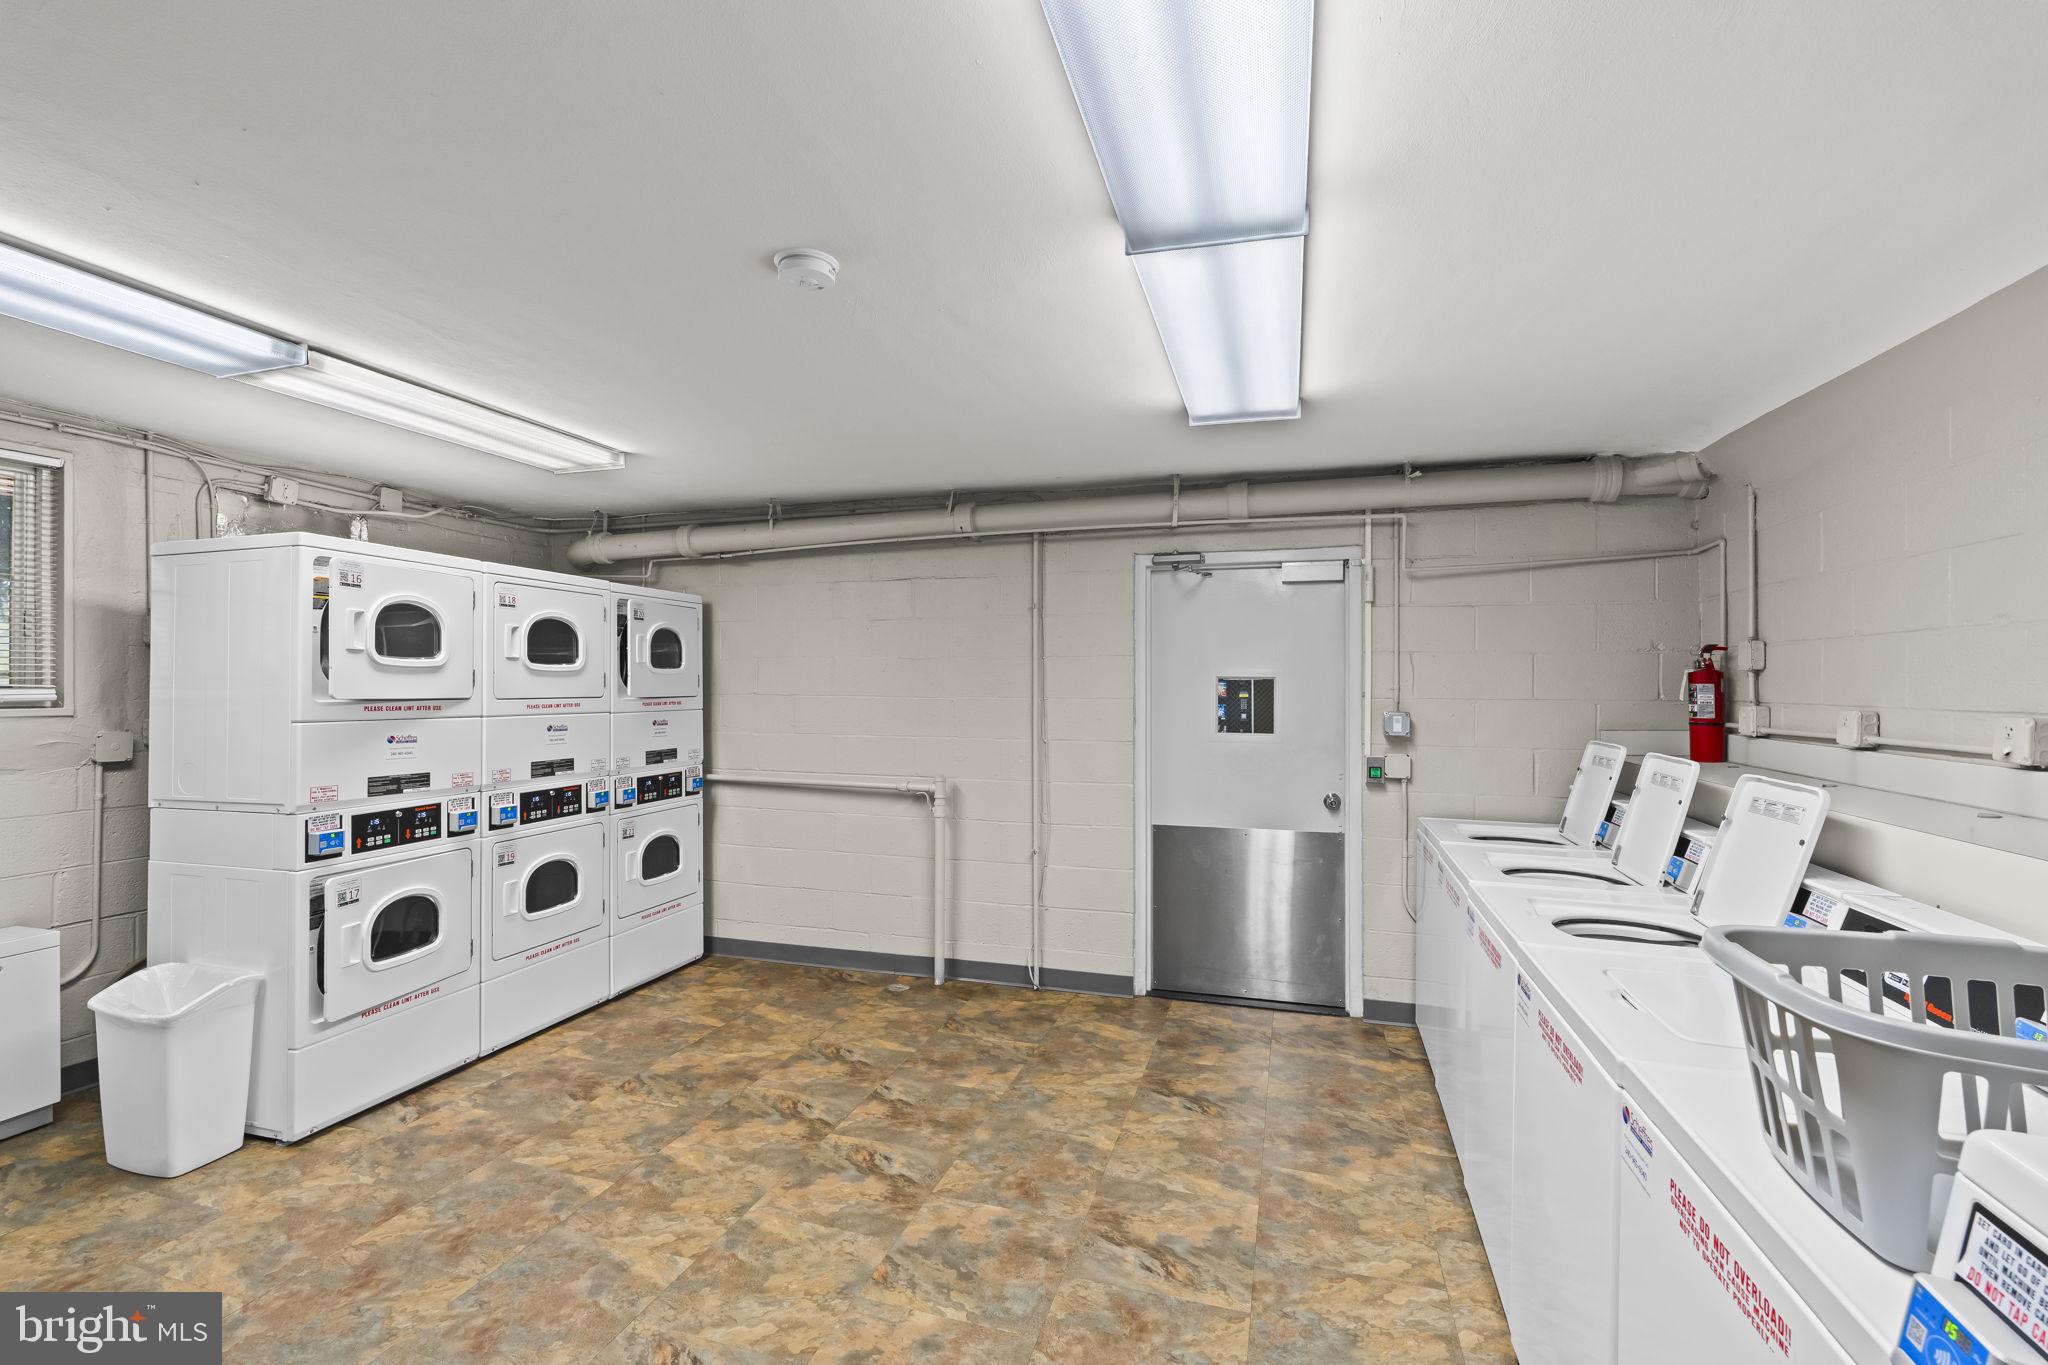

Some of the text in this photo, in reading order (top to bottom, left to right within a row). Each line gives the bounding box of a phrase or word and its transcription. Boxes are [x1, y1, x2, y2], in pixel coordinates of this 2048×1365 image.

[351, 574, 362, 583] 16
[508, 596, 516, 604] 18
[506, 852, 514, 861] 19
[349, 889, 359, 899] 17
[526, 952, 539, 960] PLEASE
[362, 1008, 381, 1018] PLEASE
[384, 1001, 400, 1010] CLEAN
[401, 996, 412, 1004] LINT
[414, 990, 429, 999] AFTER
[1670, 1178, 1792, 1347] PLEASE DO NOT OVERLOAD!!
[1680, 1218, 1690, 1238] NOT
[1693, 1236, 1699, 1251] TO
[1702, 1250, 1730, 1294] OPERATE
[1978, 1216, 2047, 1278] SET CARD IN CARD
[1984, 1237, 1999, 1254] AND
[2002, 1250, 2015, 1266] LET
[2018, 1264, 2028, 1277] GO
[2030, 1275, 2041, 1287] OF
[1671, 1196, 1789, 1358] OVERLOADING CAN CAUSE MACHINE
[1966, 1266, 1981, 1287] DO
[1984, 1281, 2005, 1307] NOT
[2008, 1300, 2028, 1328] TAP
[1979, 1246, 1999, 1269] UNTIL
[2002, 1265, 2036, 1300] MACHINE
[1981, 1261, 1998, 1283] THEN
[2001, 1279, 2032, 1311] REMOVE
